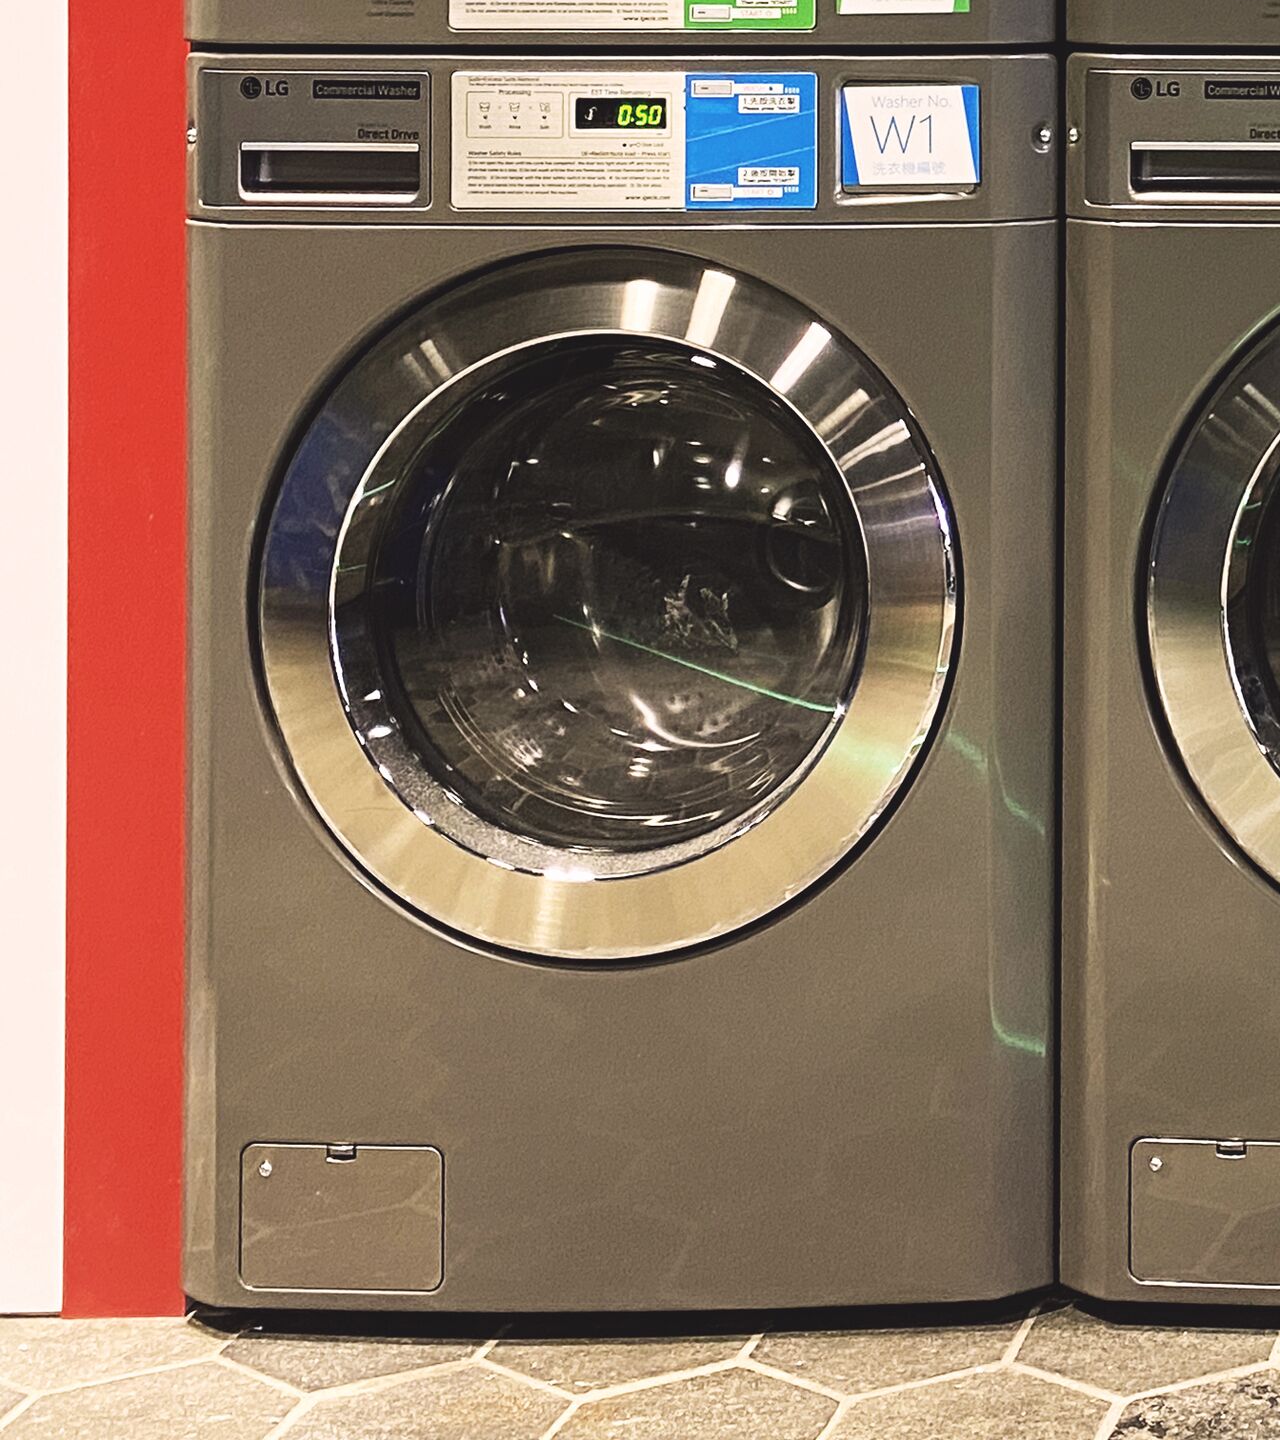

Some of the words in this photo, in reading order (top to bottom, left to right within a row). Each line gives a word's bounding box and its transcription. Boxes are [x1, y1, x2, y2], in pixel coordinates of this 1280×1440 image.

[266, 80, 288, 96] LG
[317, 85, 375, 95] Commercial
[378, 86, 417, 96] Washer
[1157, 82, 1180, 96] LG
[1208, 85, 1267, 95] Commercial
[872, 96, 924, 108] Washer
[928, 96, 952, 108] No.
[618, 104, 662, 126] 0.50
[358, 129, 389, 139] Direct
[392, 129, 419, 139] Drive
[870, 115, 932, 154] W1
[1250, 129, 1280, 139] Direct
